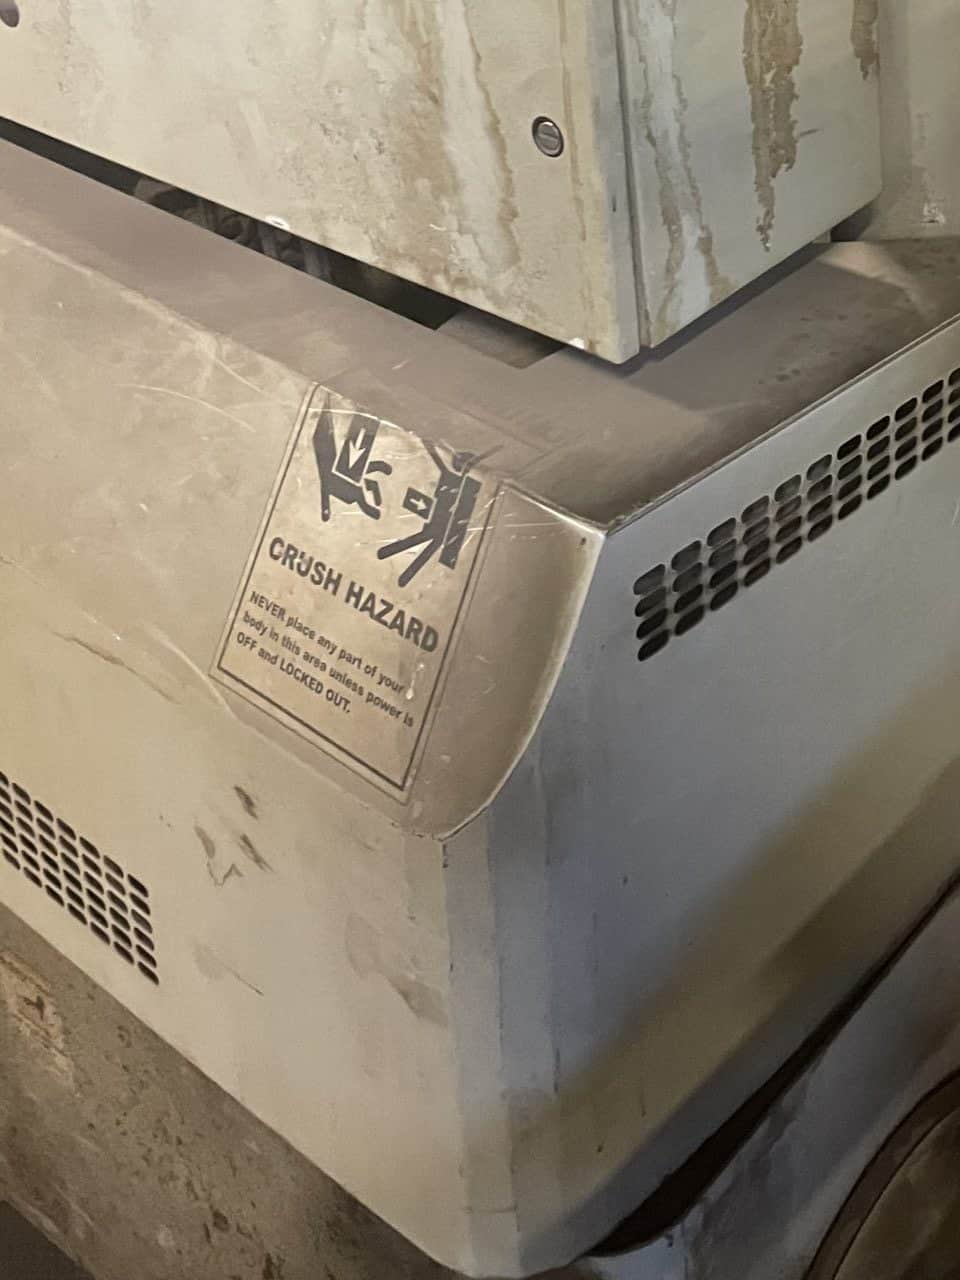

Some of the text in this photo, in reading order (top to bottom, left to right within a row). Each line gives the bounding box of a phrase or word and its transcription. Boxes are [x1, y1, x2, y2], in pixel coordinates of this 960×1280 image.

[250, 591, 406, 695] NEVER place any part of your
[269, 536, 440, 653] CRUSH HAZARD
[236, 631, 258, 651] OFF
[257, 646, 279, 666] and
[279, 658, 324, 695] LOCKED
[242, 610, 414, 727] body in this area unless power is
